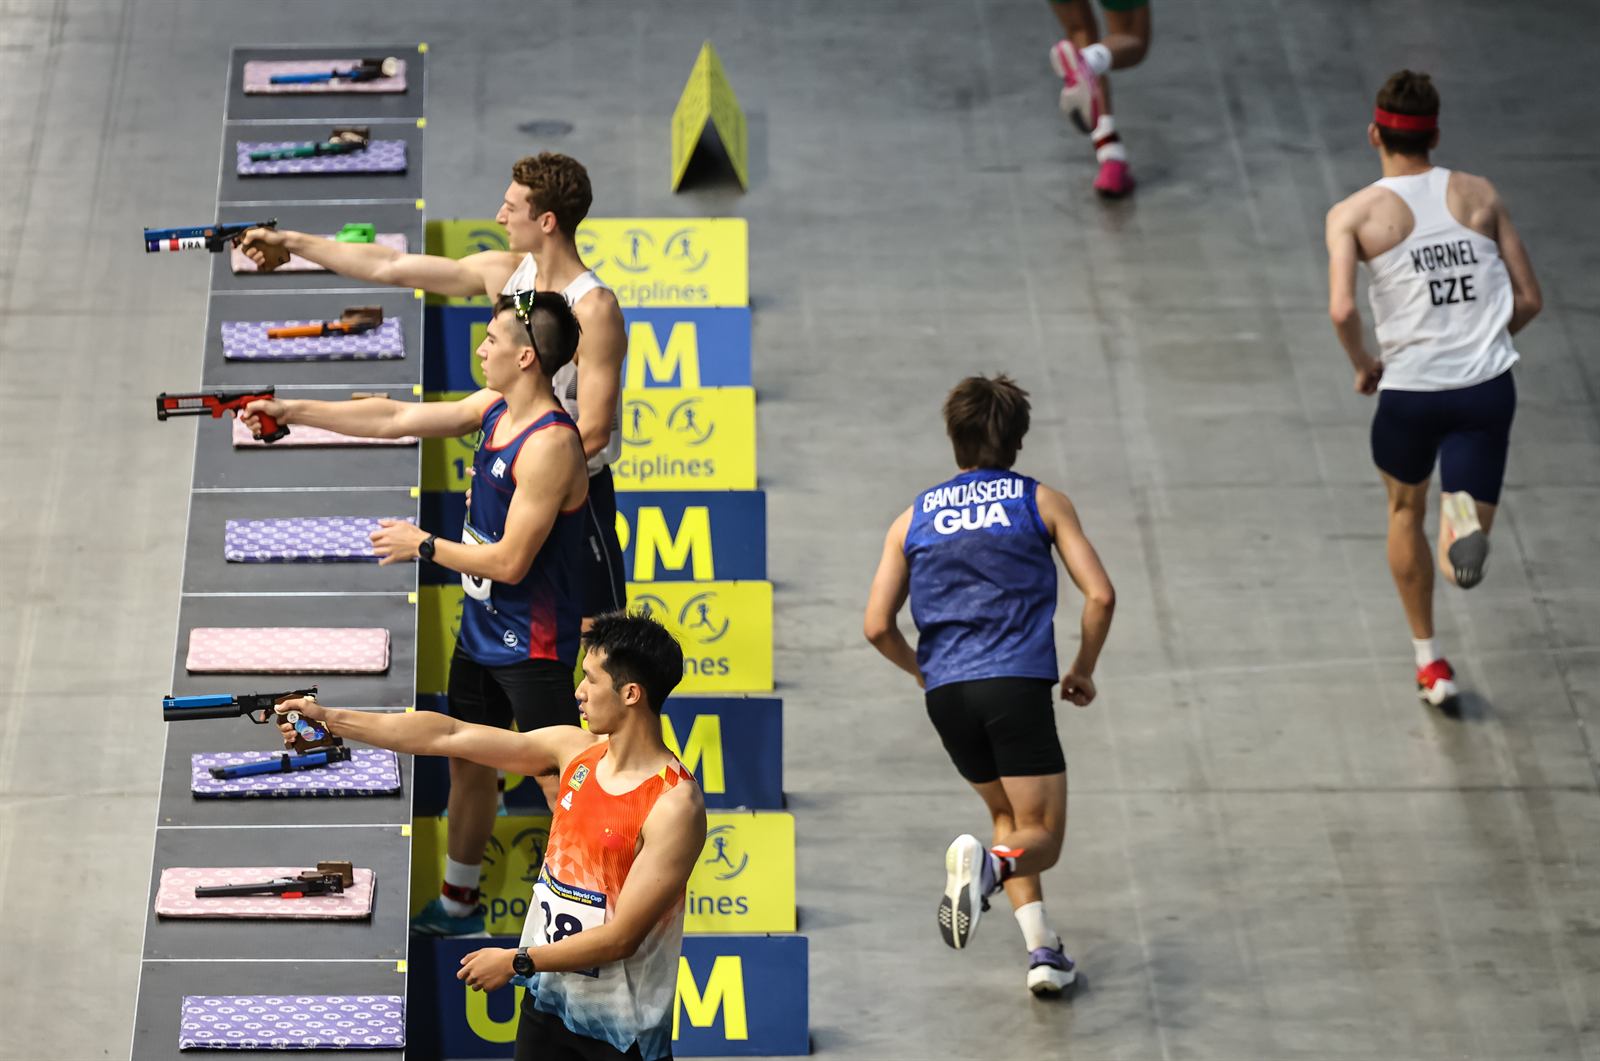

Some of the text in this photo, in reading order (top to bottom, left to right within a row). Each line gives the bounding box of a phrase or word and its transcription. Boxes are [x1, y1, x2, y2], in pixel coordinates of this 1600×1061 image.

[1410, 240, 1479, 273] KORNEL
[611, 280, 710, 307] ciplines
[1428, 275, 1477, 306] CZE
[934, 502, 1011, 534] GUA
[573, 889, 590, 900] World
[590, 895, 603, 903] Cup
